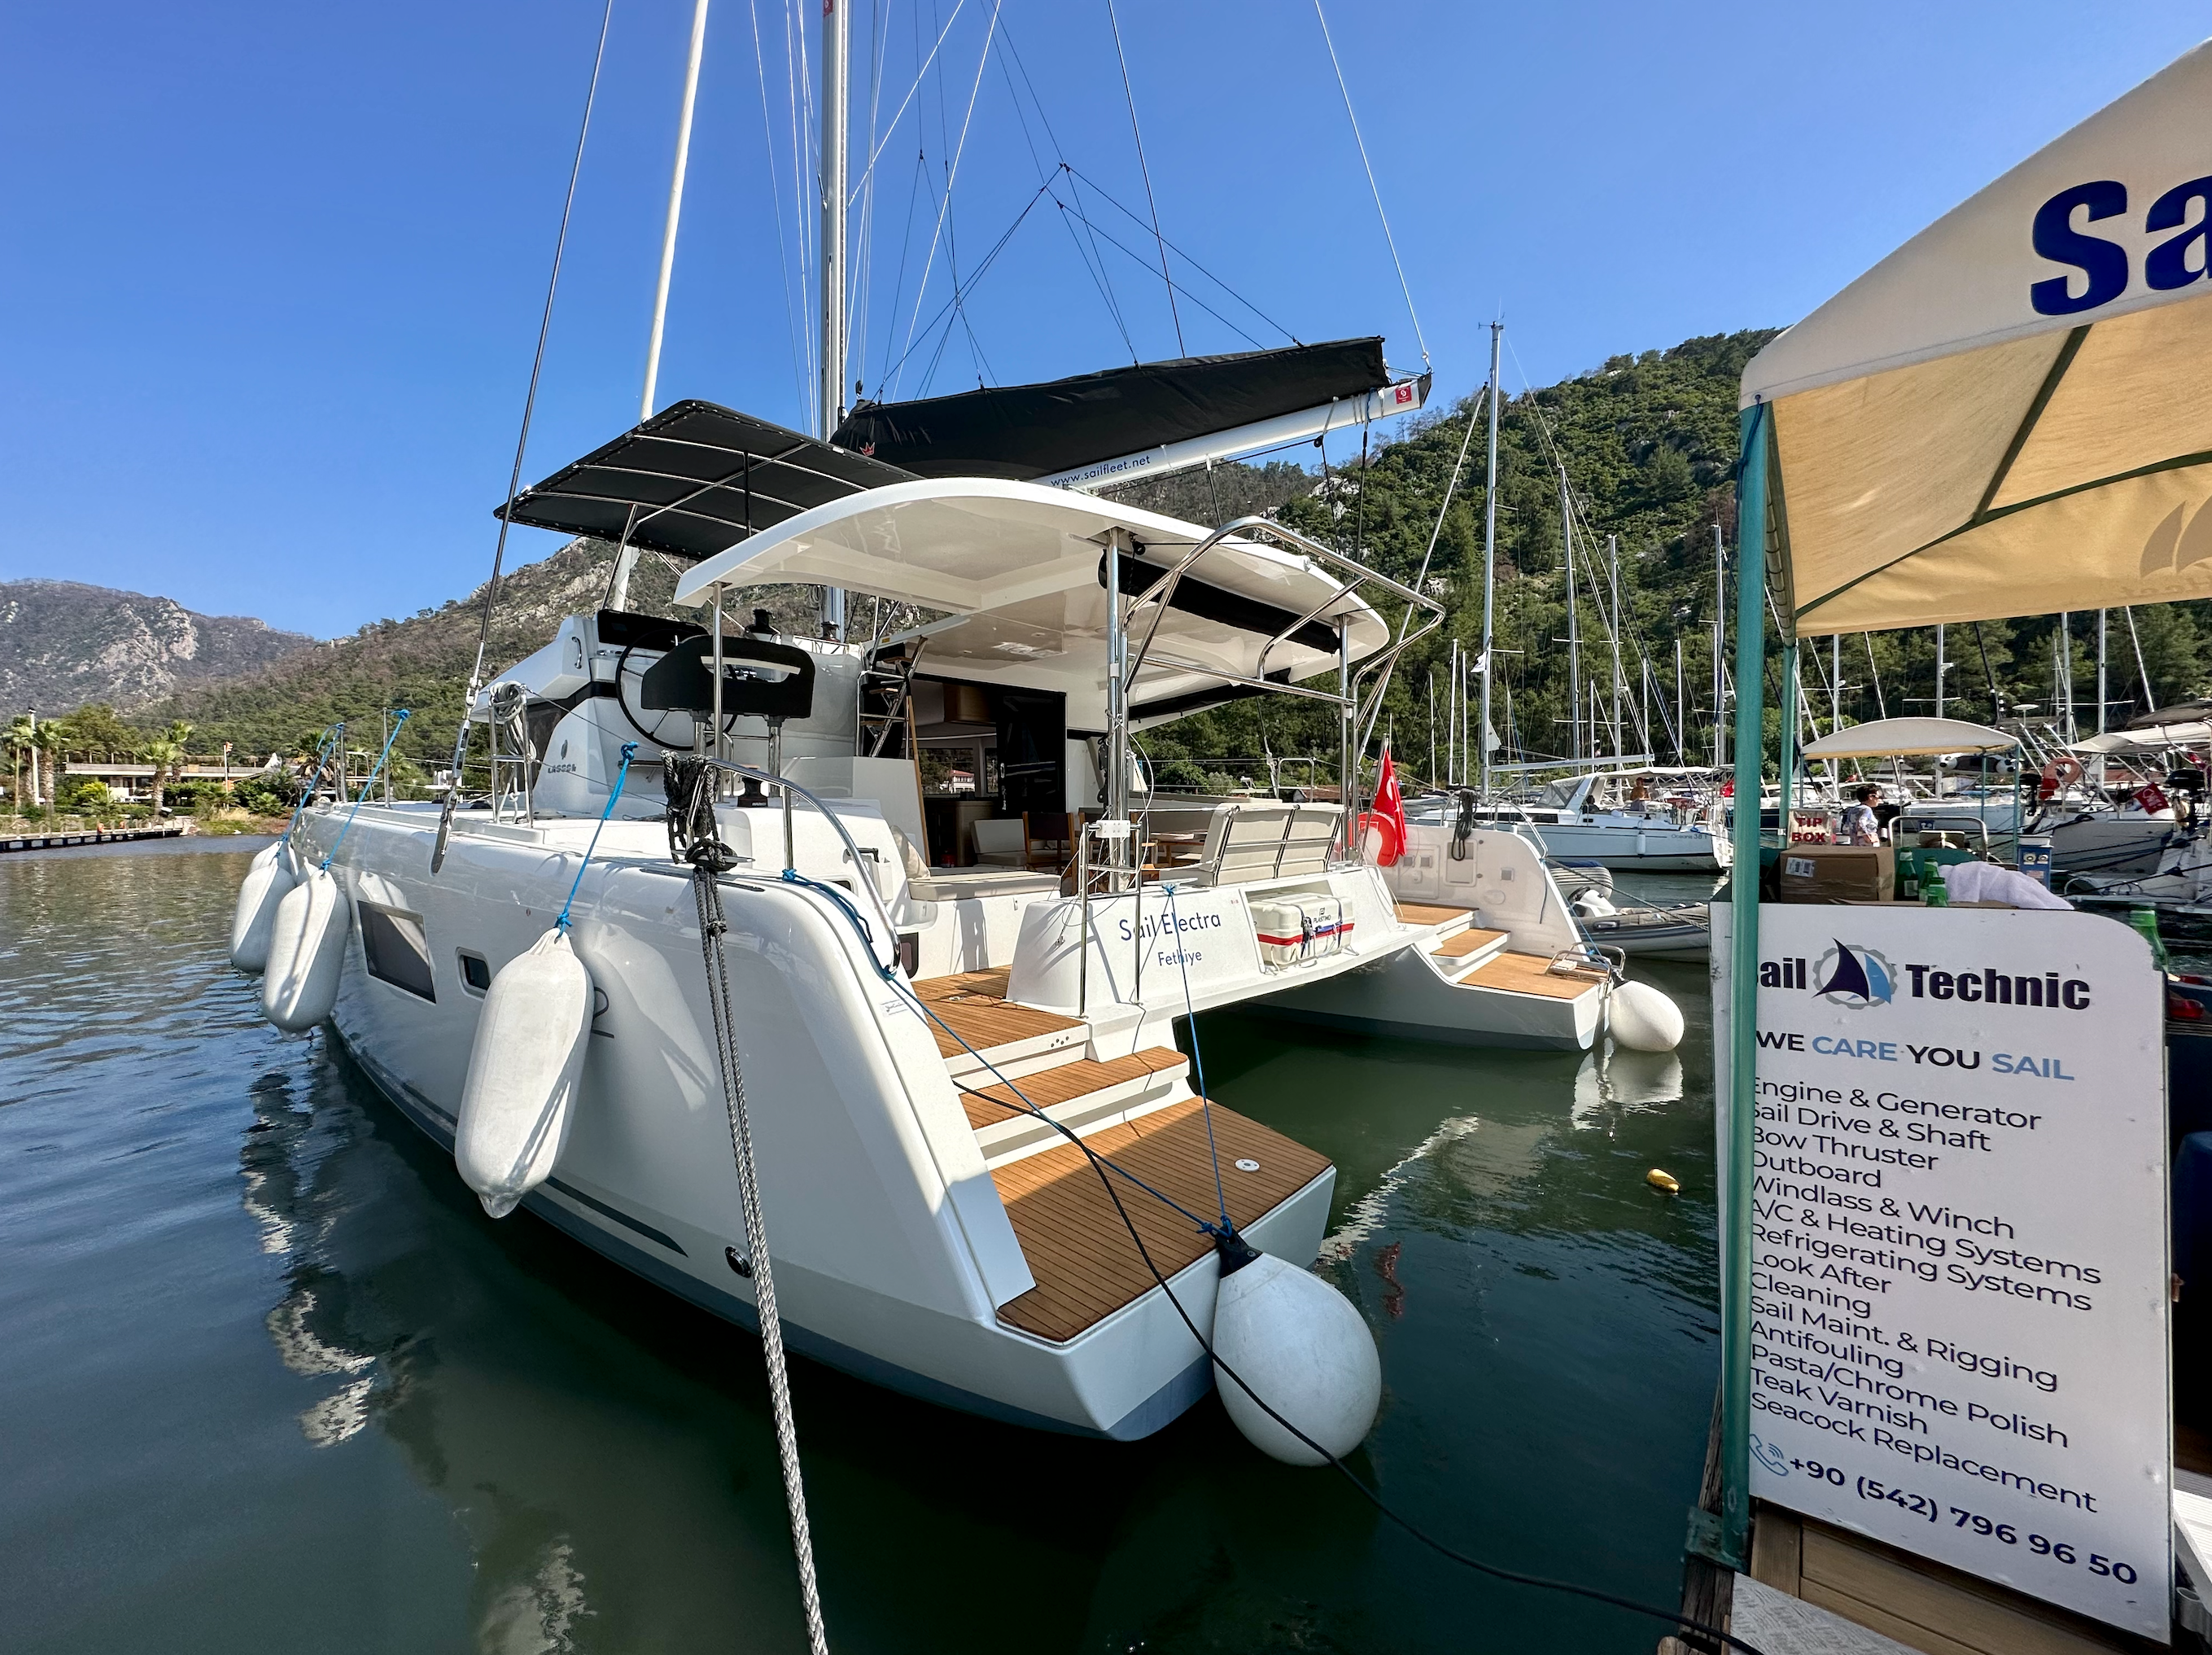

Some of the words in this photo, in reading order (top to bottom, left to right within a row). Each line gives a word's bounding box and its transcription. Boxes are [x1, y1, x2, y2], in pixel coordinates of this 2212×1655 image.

[2031, 175, 2212, 316] Sa
[1051, 455, 1150, 487] www.sailfleet.net
[1791, 832, 1826, 843] BOX
[1796, 817, 1823, 827] TIP
[1119, 915, 1156, 941] Sail
[1161, 912, 1221, 935] Electra
[1158, 949, 1202, 966] Fethiye
[1757, 957, 1807, 990] ail
[1905, 964, 2090, 1010] Technic
[1755, 1030, 1805, 1052] WE
[1812, 1035, 1898, 1062] CARE
[1905, 1044, 1980, 1070] YOU
[1991, 1053, 2075, 1081] SAIL
[1798, 1107, 1871, 1134] Drive
[1878, 1119, 1899, 1138] &
[1907, 1123, 1991, 1152] Shaft
[1849, 1088, 1870, 1108] &
[1877, 1092, 2042, 1130] Generator
[1754, 1149, 1881, 1188] Outboard
[1812, 1134, 1939, 1170] Thruster
[1753, 1199, 1794, 1222] A/C
[1800, 1209, 1820, 1228] &
[1828, 1213, 1946, 1257] Heating
[1955, 1238, 2101, 1284] Systems
[1879, 1197, 1901, 1218] &
[1907, 1202, 2014, 1239] Winch
[1752, 1223, 1937, 1282] Refrigerating
[1947, 1263, 2092, 1311] Systems
[1820, 1263, 1892, 1294] After
[1751, 1272, 1870, 1319] Cleaning
[1751, 1296, 1793, 1321] Sail
[1803, 1307, 1890, 1346] Maint.
[1897, 1332, 1918, 1353] &
[1927, 1338, 2057, 1393] Rigging
[1751, 1320, 1903, 1378] Antifouling
[1751, 1367, 1812, 1401] Teak
[1817, 1386, 1927, 1434] Varnish
[1752, 1343, 1958, 1415] Pasta/Chrome
[1968, 1402, 2068, 1448] Polish
[1751, 1392, 1866, 1443] Seacock
[1874, 1427, 2097, 1513] Replacement
[1790, 1458, 1845, 1486] +90
[1857, 1476, 1938, 1522] (542)
[1950, 1507, 2017, 1545] 796
[2028, 1534, 2077, 1565] 96
[2087, 1552, 2138, 1585] 50
